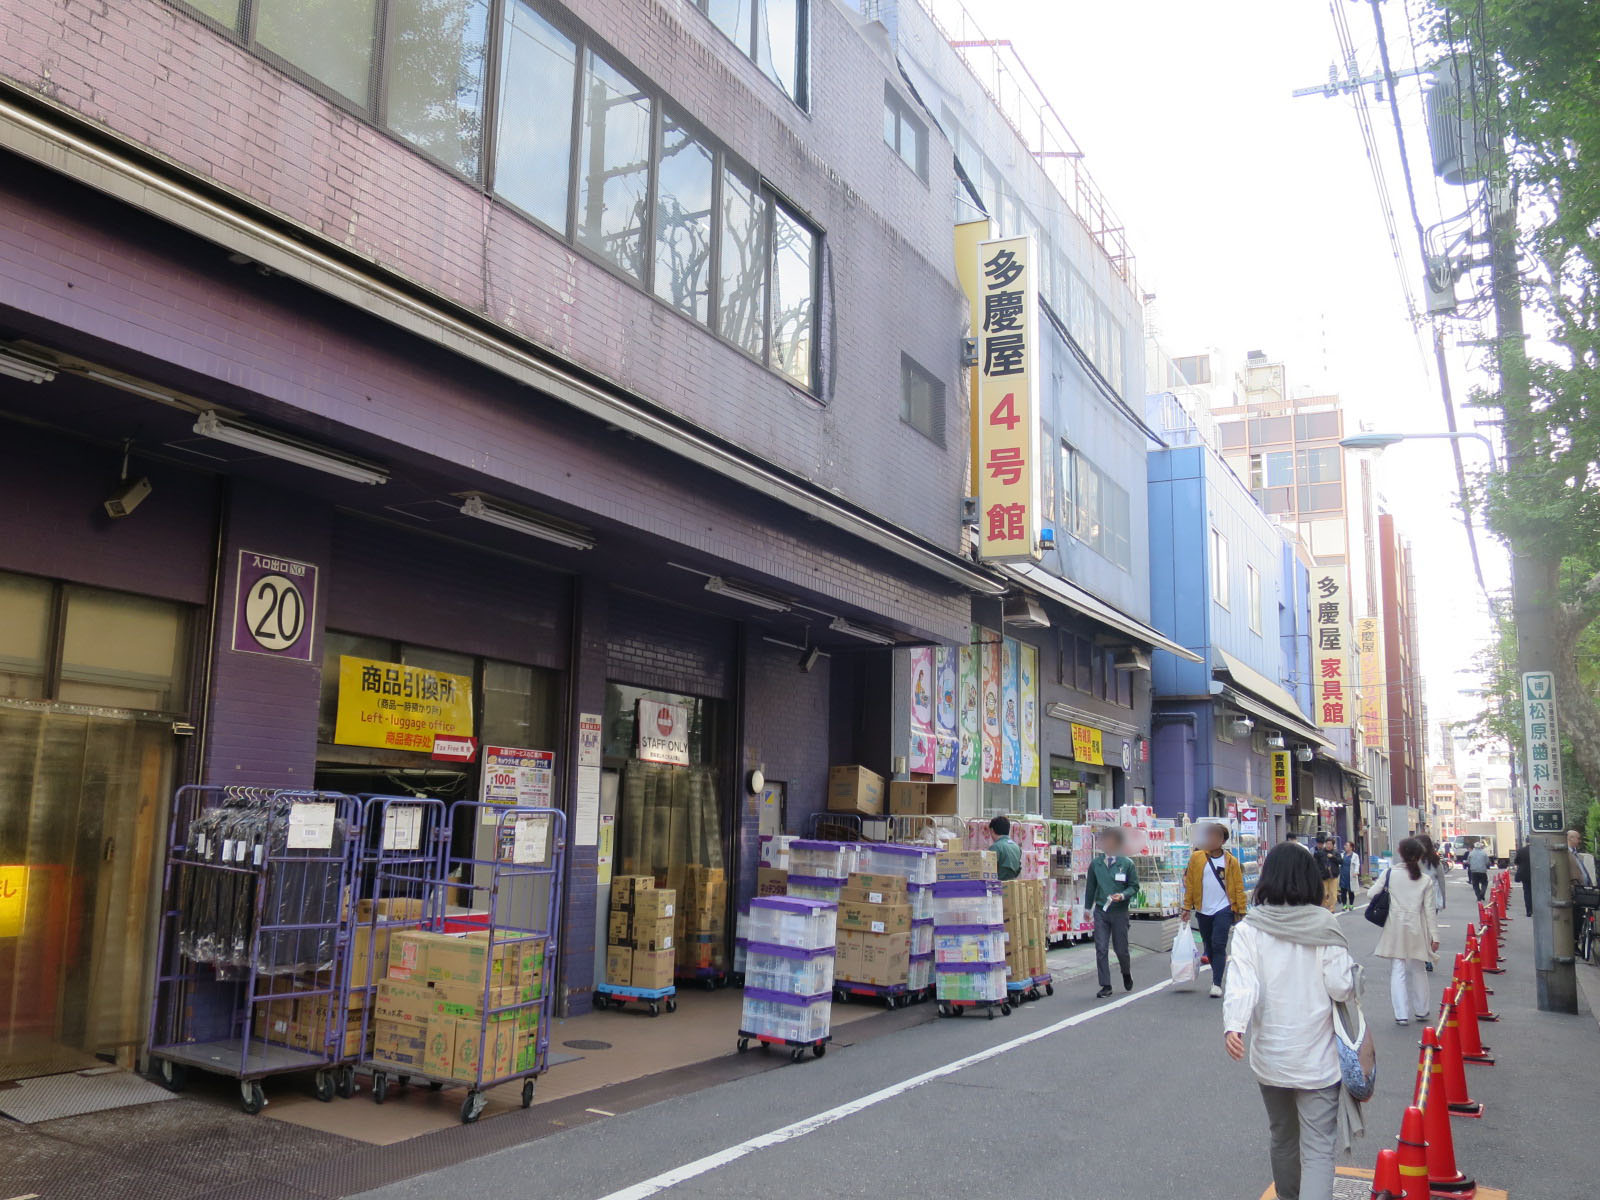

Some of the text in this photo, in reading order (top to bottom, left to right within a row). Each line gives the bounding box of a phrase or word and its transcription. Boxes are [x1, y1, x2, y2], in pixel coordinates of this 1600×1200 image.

[983, 249, 1026, 541] 多慶屋 4号館
[252, 555, 289, 574] 入口出口
[254, 582, 300, 642] 20
[1317, 575, 1344, 724] 多慶屋 家具館
[361, 664, 456, 704] 商品引換所
[428, 719, 456, 732] office
[642, 736, 688, 753] STAFF ONLY
[1529, 702, 1550, 782] 松原歯科
